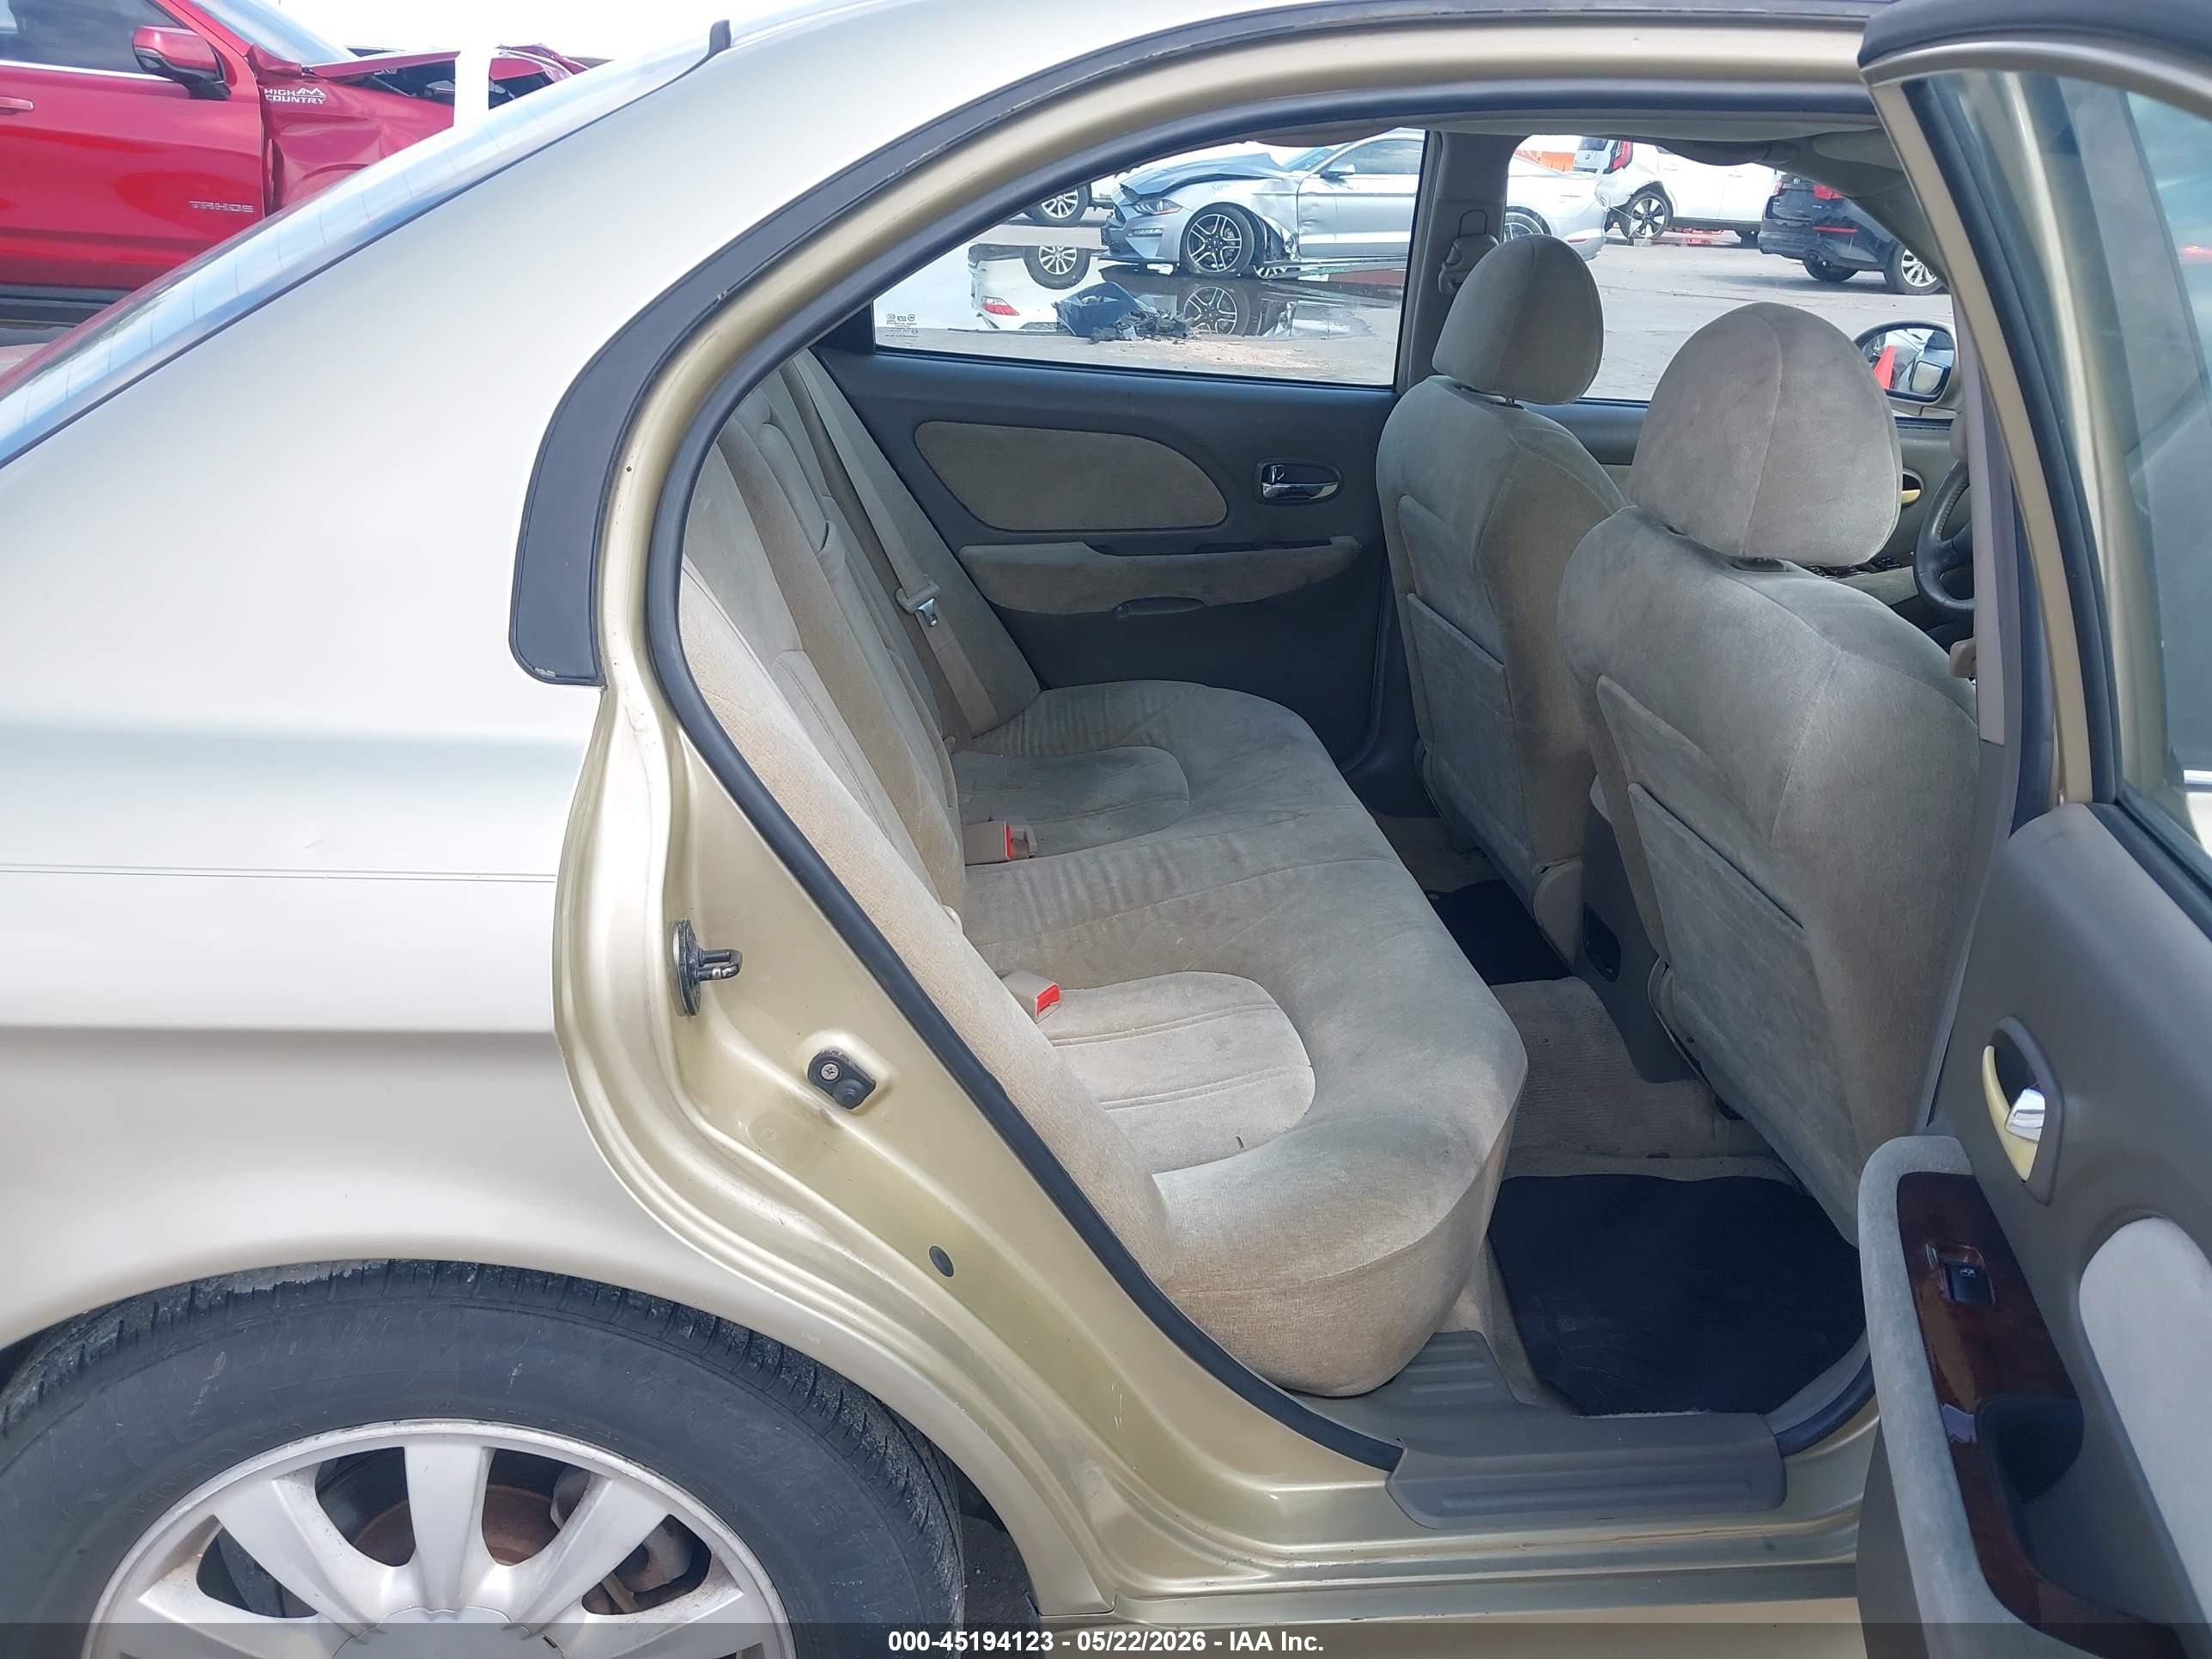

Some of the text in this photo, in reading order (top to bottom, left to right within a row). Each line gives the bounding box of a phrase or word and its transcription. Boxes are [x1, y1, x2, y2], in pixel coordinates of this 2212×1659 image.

[264, 88, 295, 96] HIGH
[264, 94, 326, 105] COUNTRY
[188, 200, 255, 213] TAHOE
